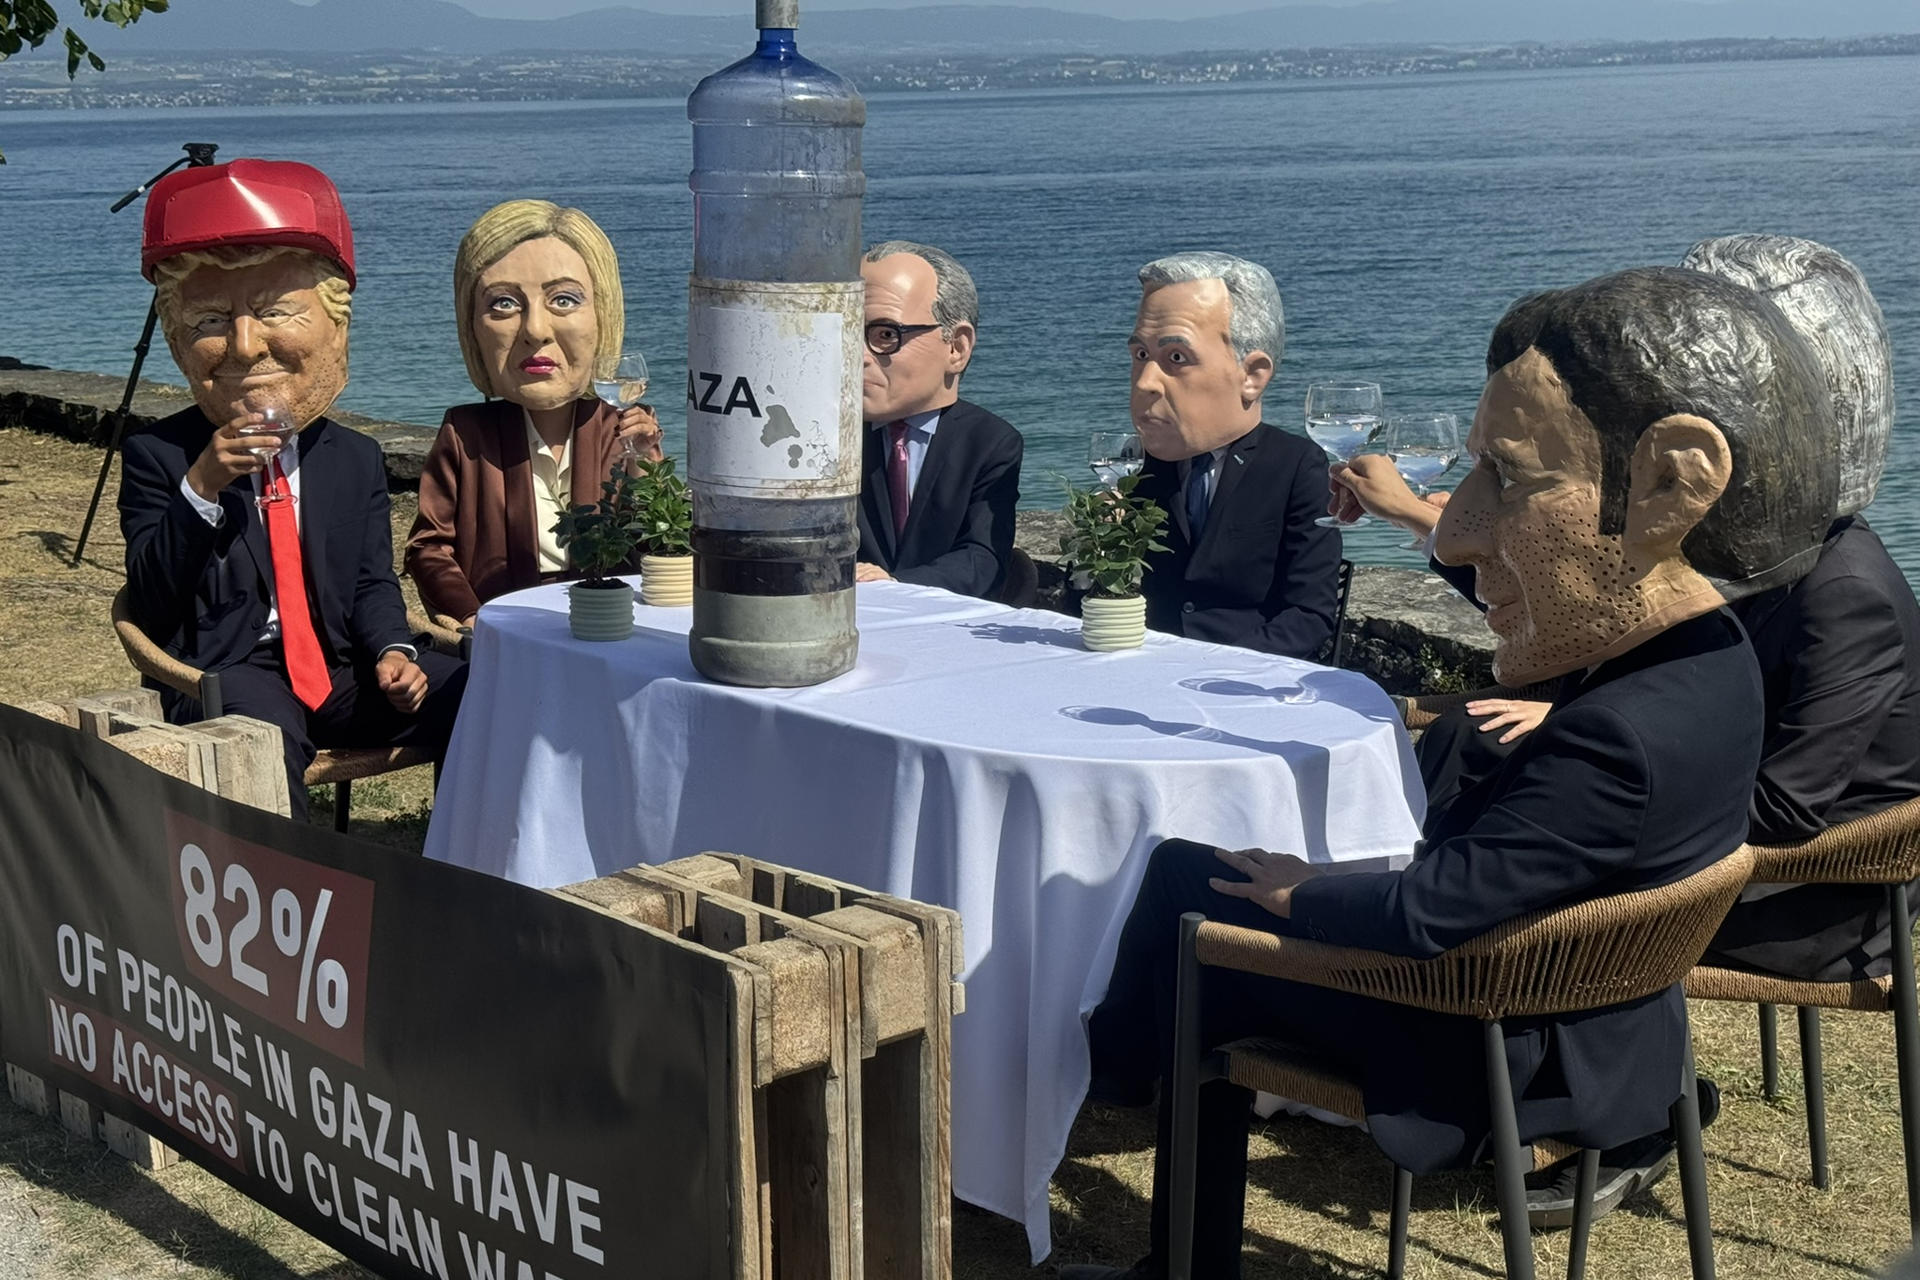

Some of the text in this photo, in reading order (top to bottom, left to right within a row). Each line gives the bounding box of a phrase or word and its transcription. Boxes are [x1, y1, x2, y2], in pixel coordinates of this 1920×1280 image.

[180, 843, 349, 1029] 82%
[49, 998, 97, 1072] NO
[112, 1028, 239, 1159] ACCESS
[245, 1111, 294, 1194] TO
[303, 1151, 450, 1280] CLEAN
[57, 924, 107, 995] OF
[117, 948, 252, 1087] PEOPLE
[254, 1034, 297, 1118] IN
[309, 1066, 435, 1190] GAZA
[448, 1130, 604, 1266] HAVE
